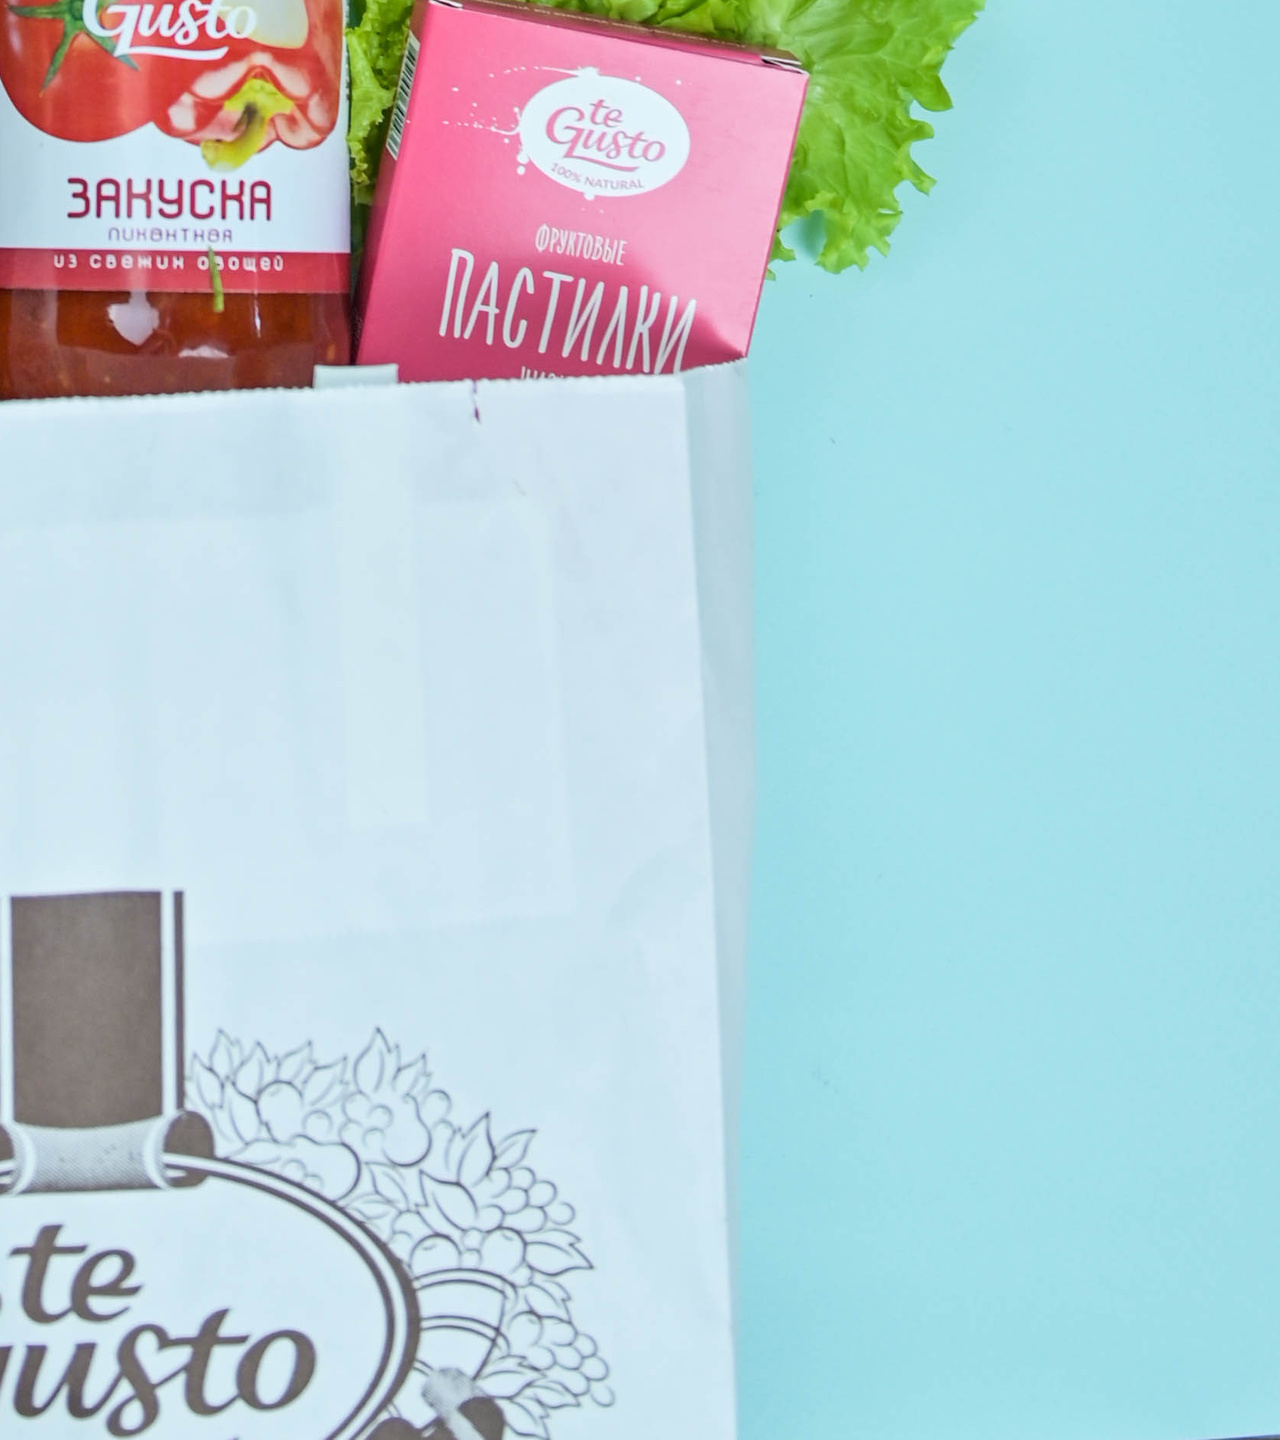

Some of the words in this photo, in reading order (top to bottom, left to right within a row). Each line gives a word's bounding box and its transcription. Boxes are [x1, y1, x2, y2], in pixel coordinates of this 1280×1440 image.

[590, 99, 622, 128] te
[546, 106, 666, 172] Gusto
[551, 162, 582, 183] 100%
[584, 176, 645, 190] NATURAL
[67, 178, 271, 221] ЗАКУСКА
[535, 223, 628, 266] ФРУКТОВЫЕ
[439, 248, 697, 374] ПАСТИЛКИ
[9, 1224, 143, 1324] te
